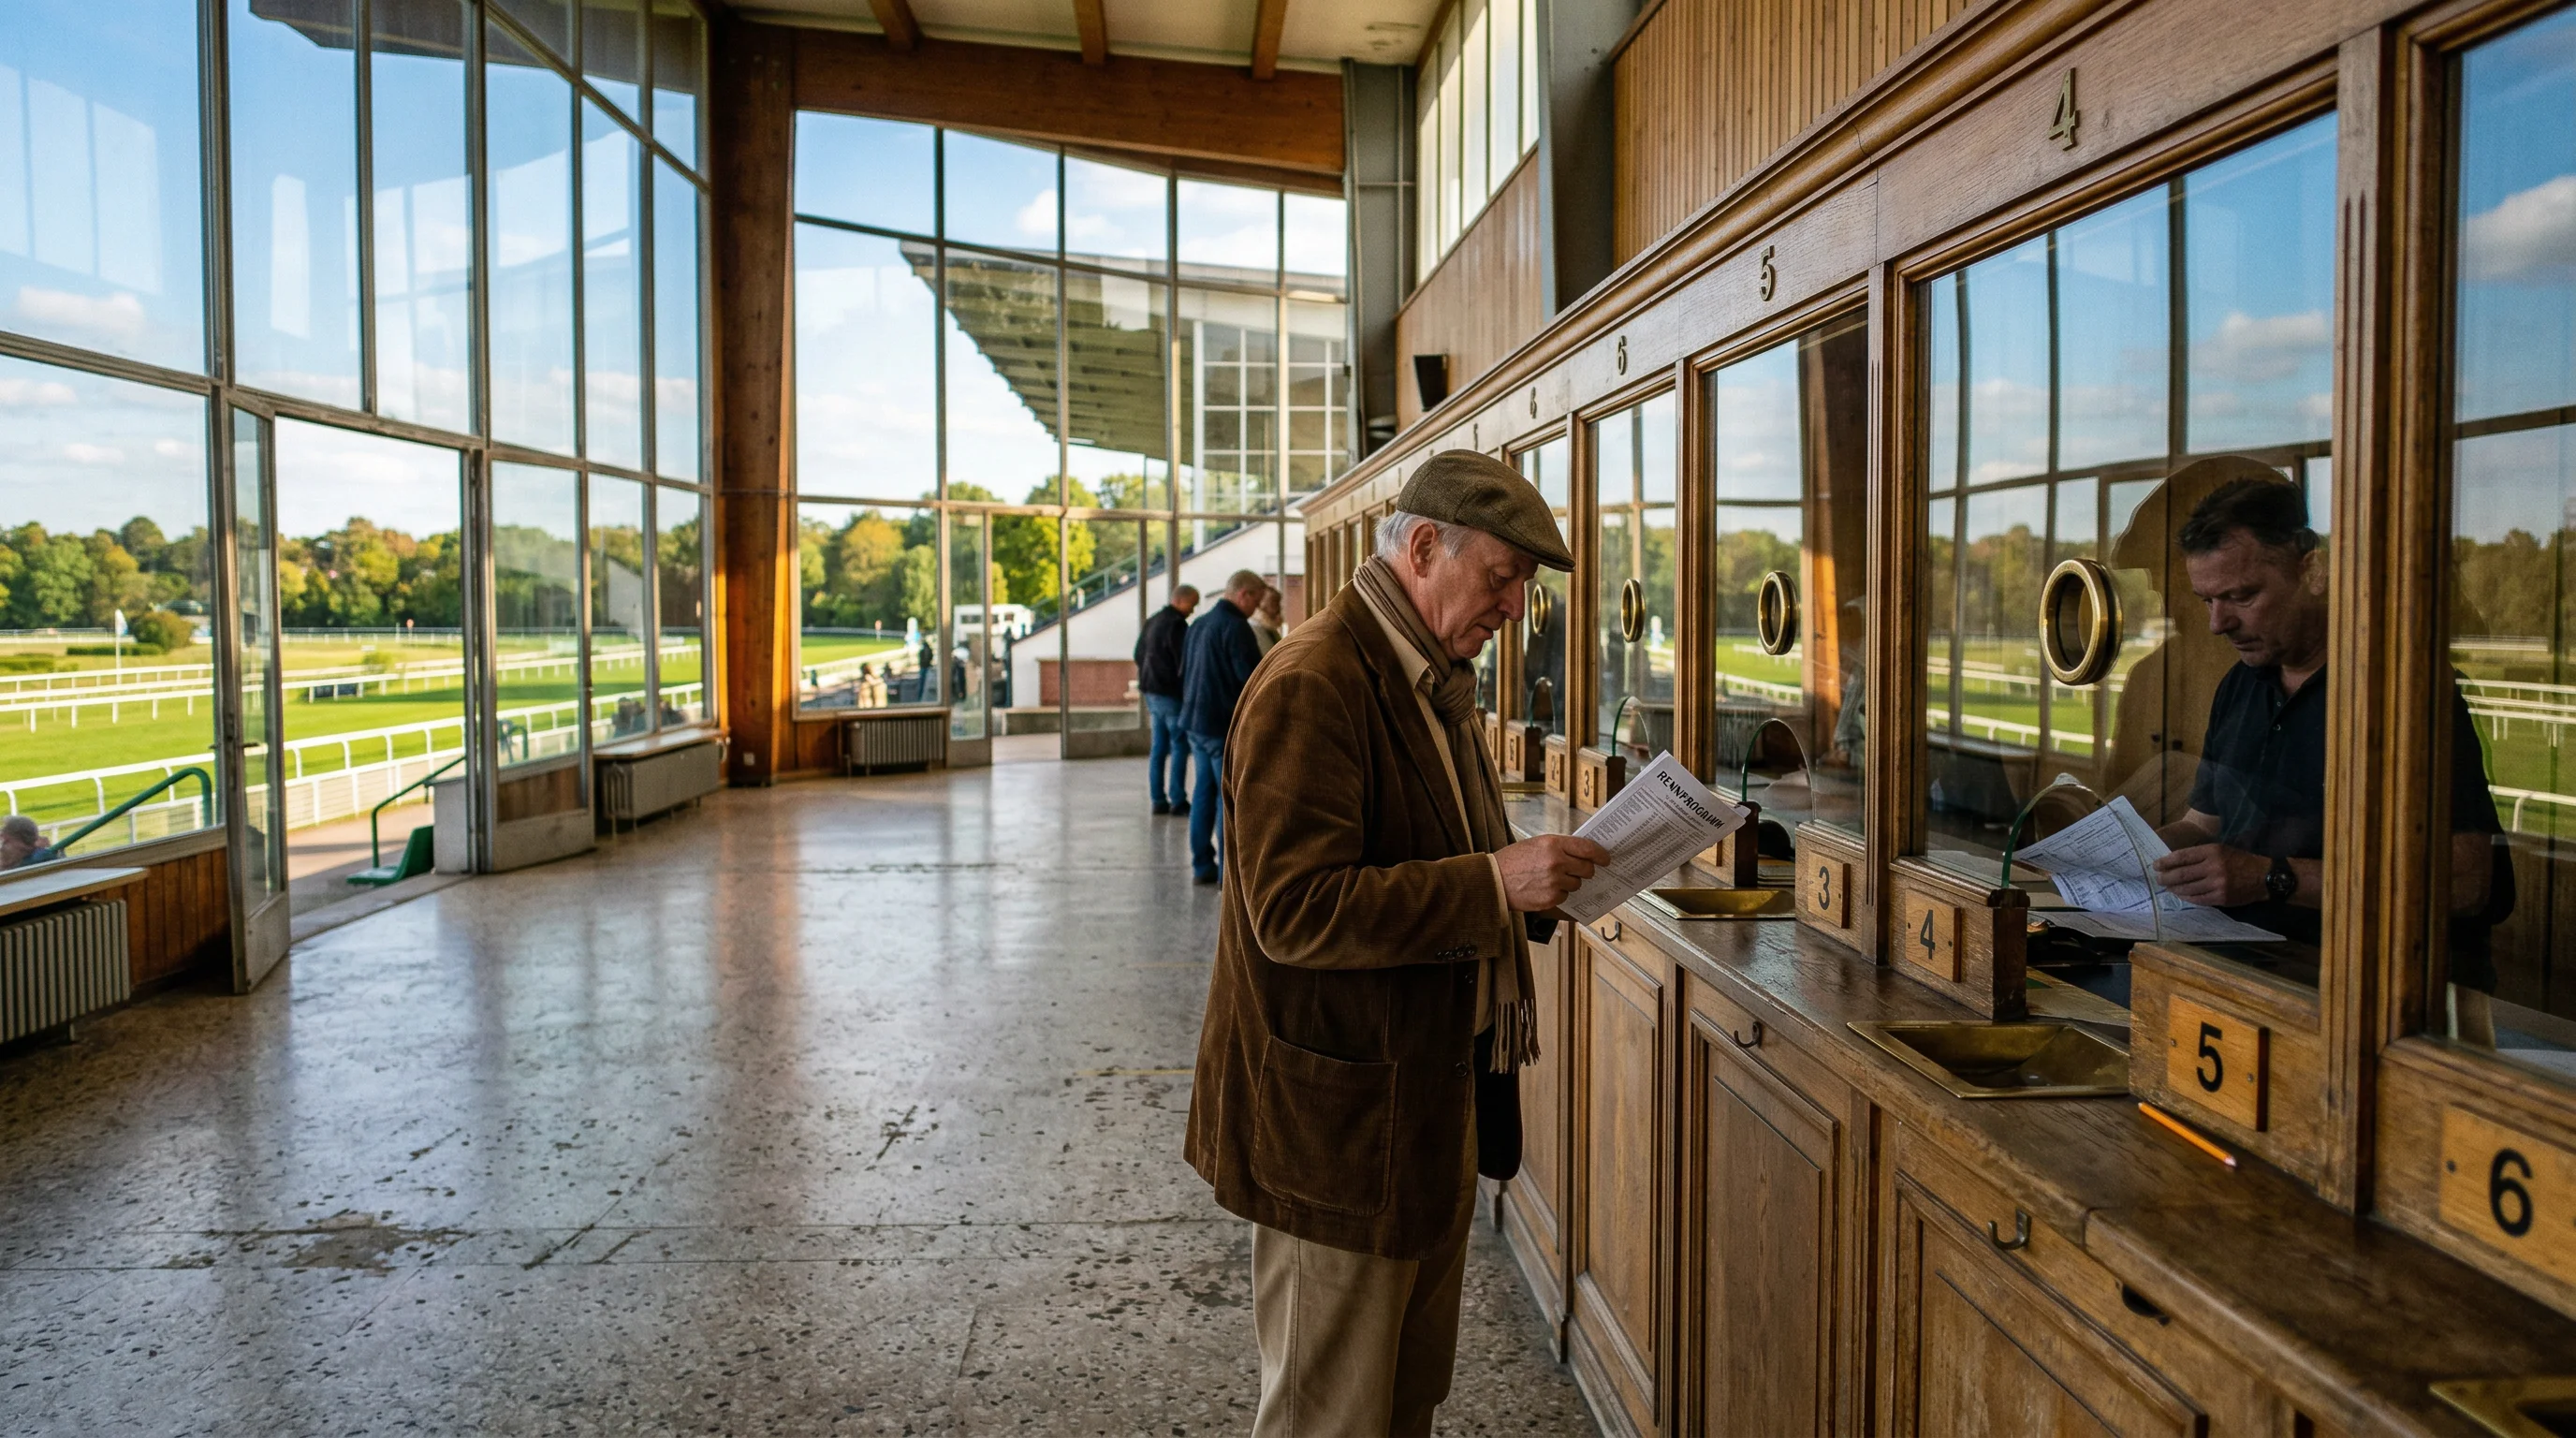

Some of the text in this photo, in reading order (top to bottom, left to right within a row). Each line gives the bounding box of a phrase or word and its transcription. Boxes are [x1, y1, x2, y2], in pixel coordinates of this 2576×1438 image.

[2048, 67, 2081, 151] 4
[1760, 245, 1776, 301] 5
[1584, 770, 1589, 797] 3
[1818, 866, 1830, 911] 3
[1920, 909, 1936, 961] 4
[2196, 1021, 2223, 1093] 5
[2490, 1148, 2533, 1238] 6
